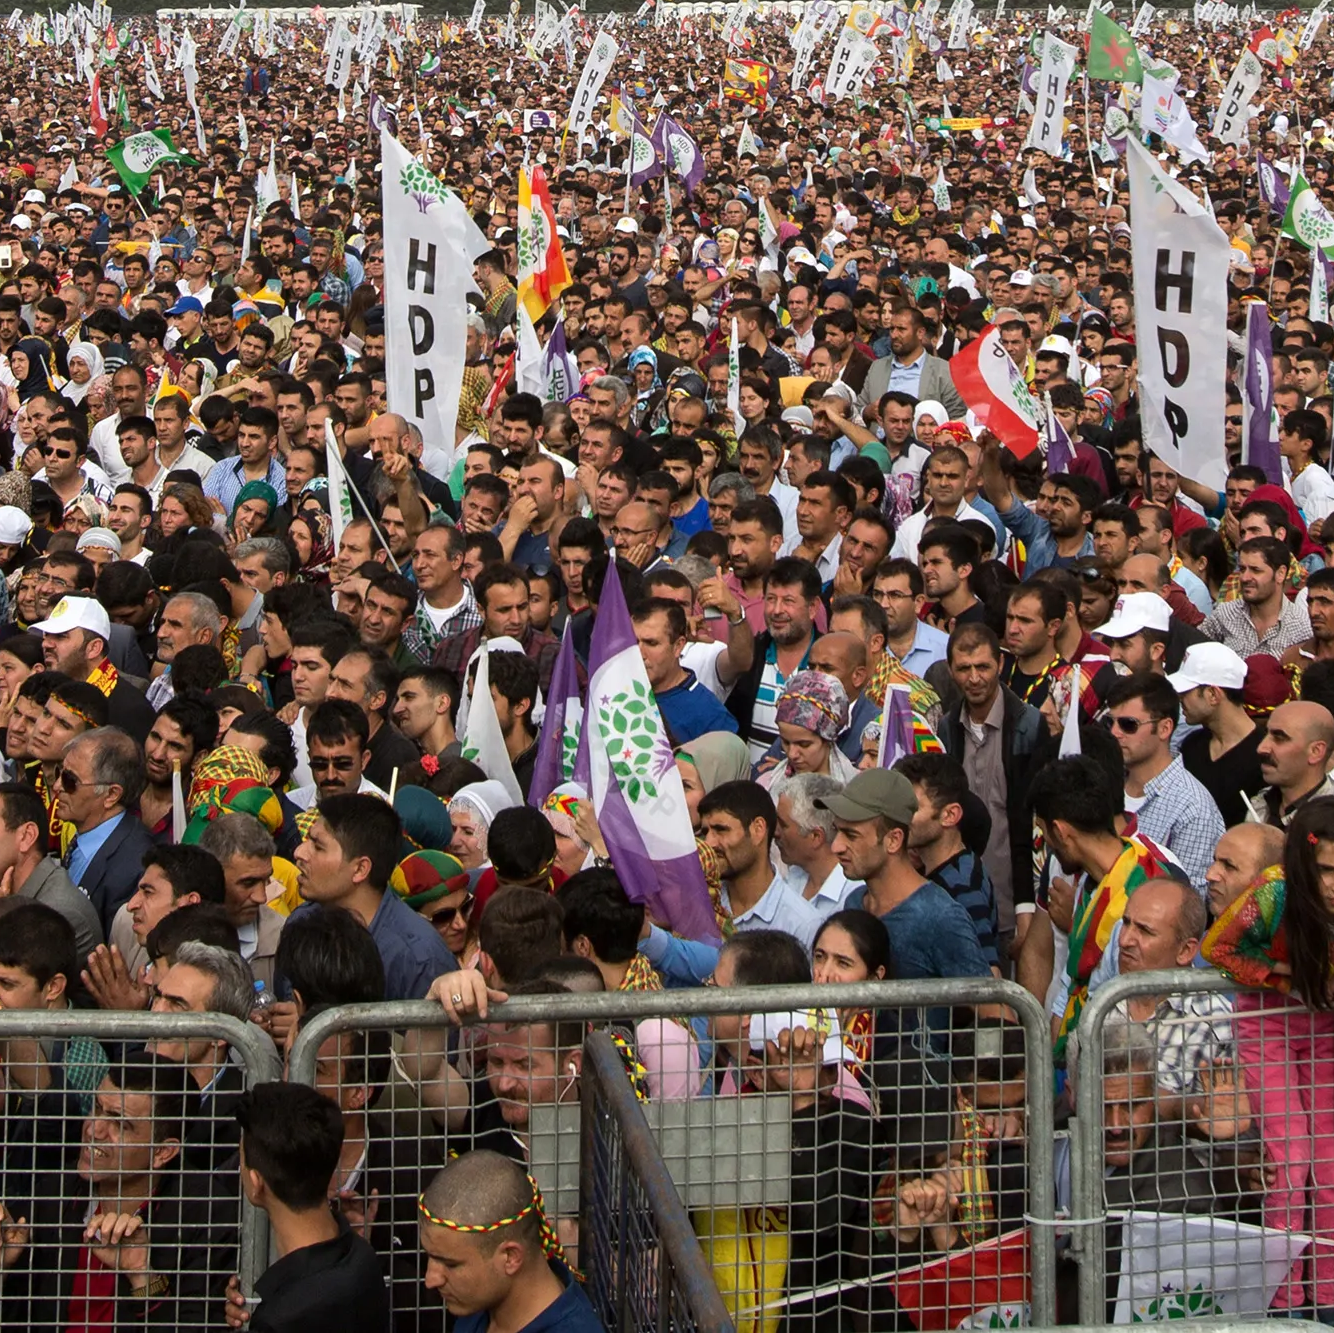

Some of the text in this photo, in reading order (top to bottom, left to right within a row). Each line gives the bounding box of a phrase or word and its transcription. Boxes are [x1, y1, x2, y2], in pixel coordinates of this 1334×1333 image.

[923, 11, 932, 35] HDP
[953, 13, 964, 45] HDP
[332, 47, 344, 82] HDP
[846, 66, 864, 92] HD
[575, 69, 599, 127] HDP
[1041, 73, 1059, 141] HDP
[1220, 80, 1245, 135] HDP
[407, 237, 437, 420] HDP
[1155, 248, 1196, 450] HDP
